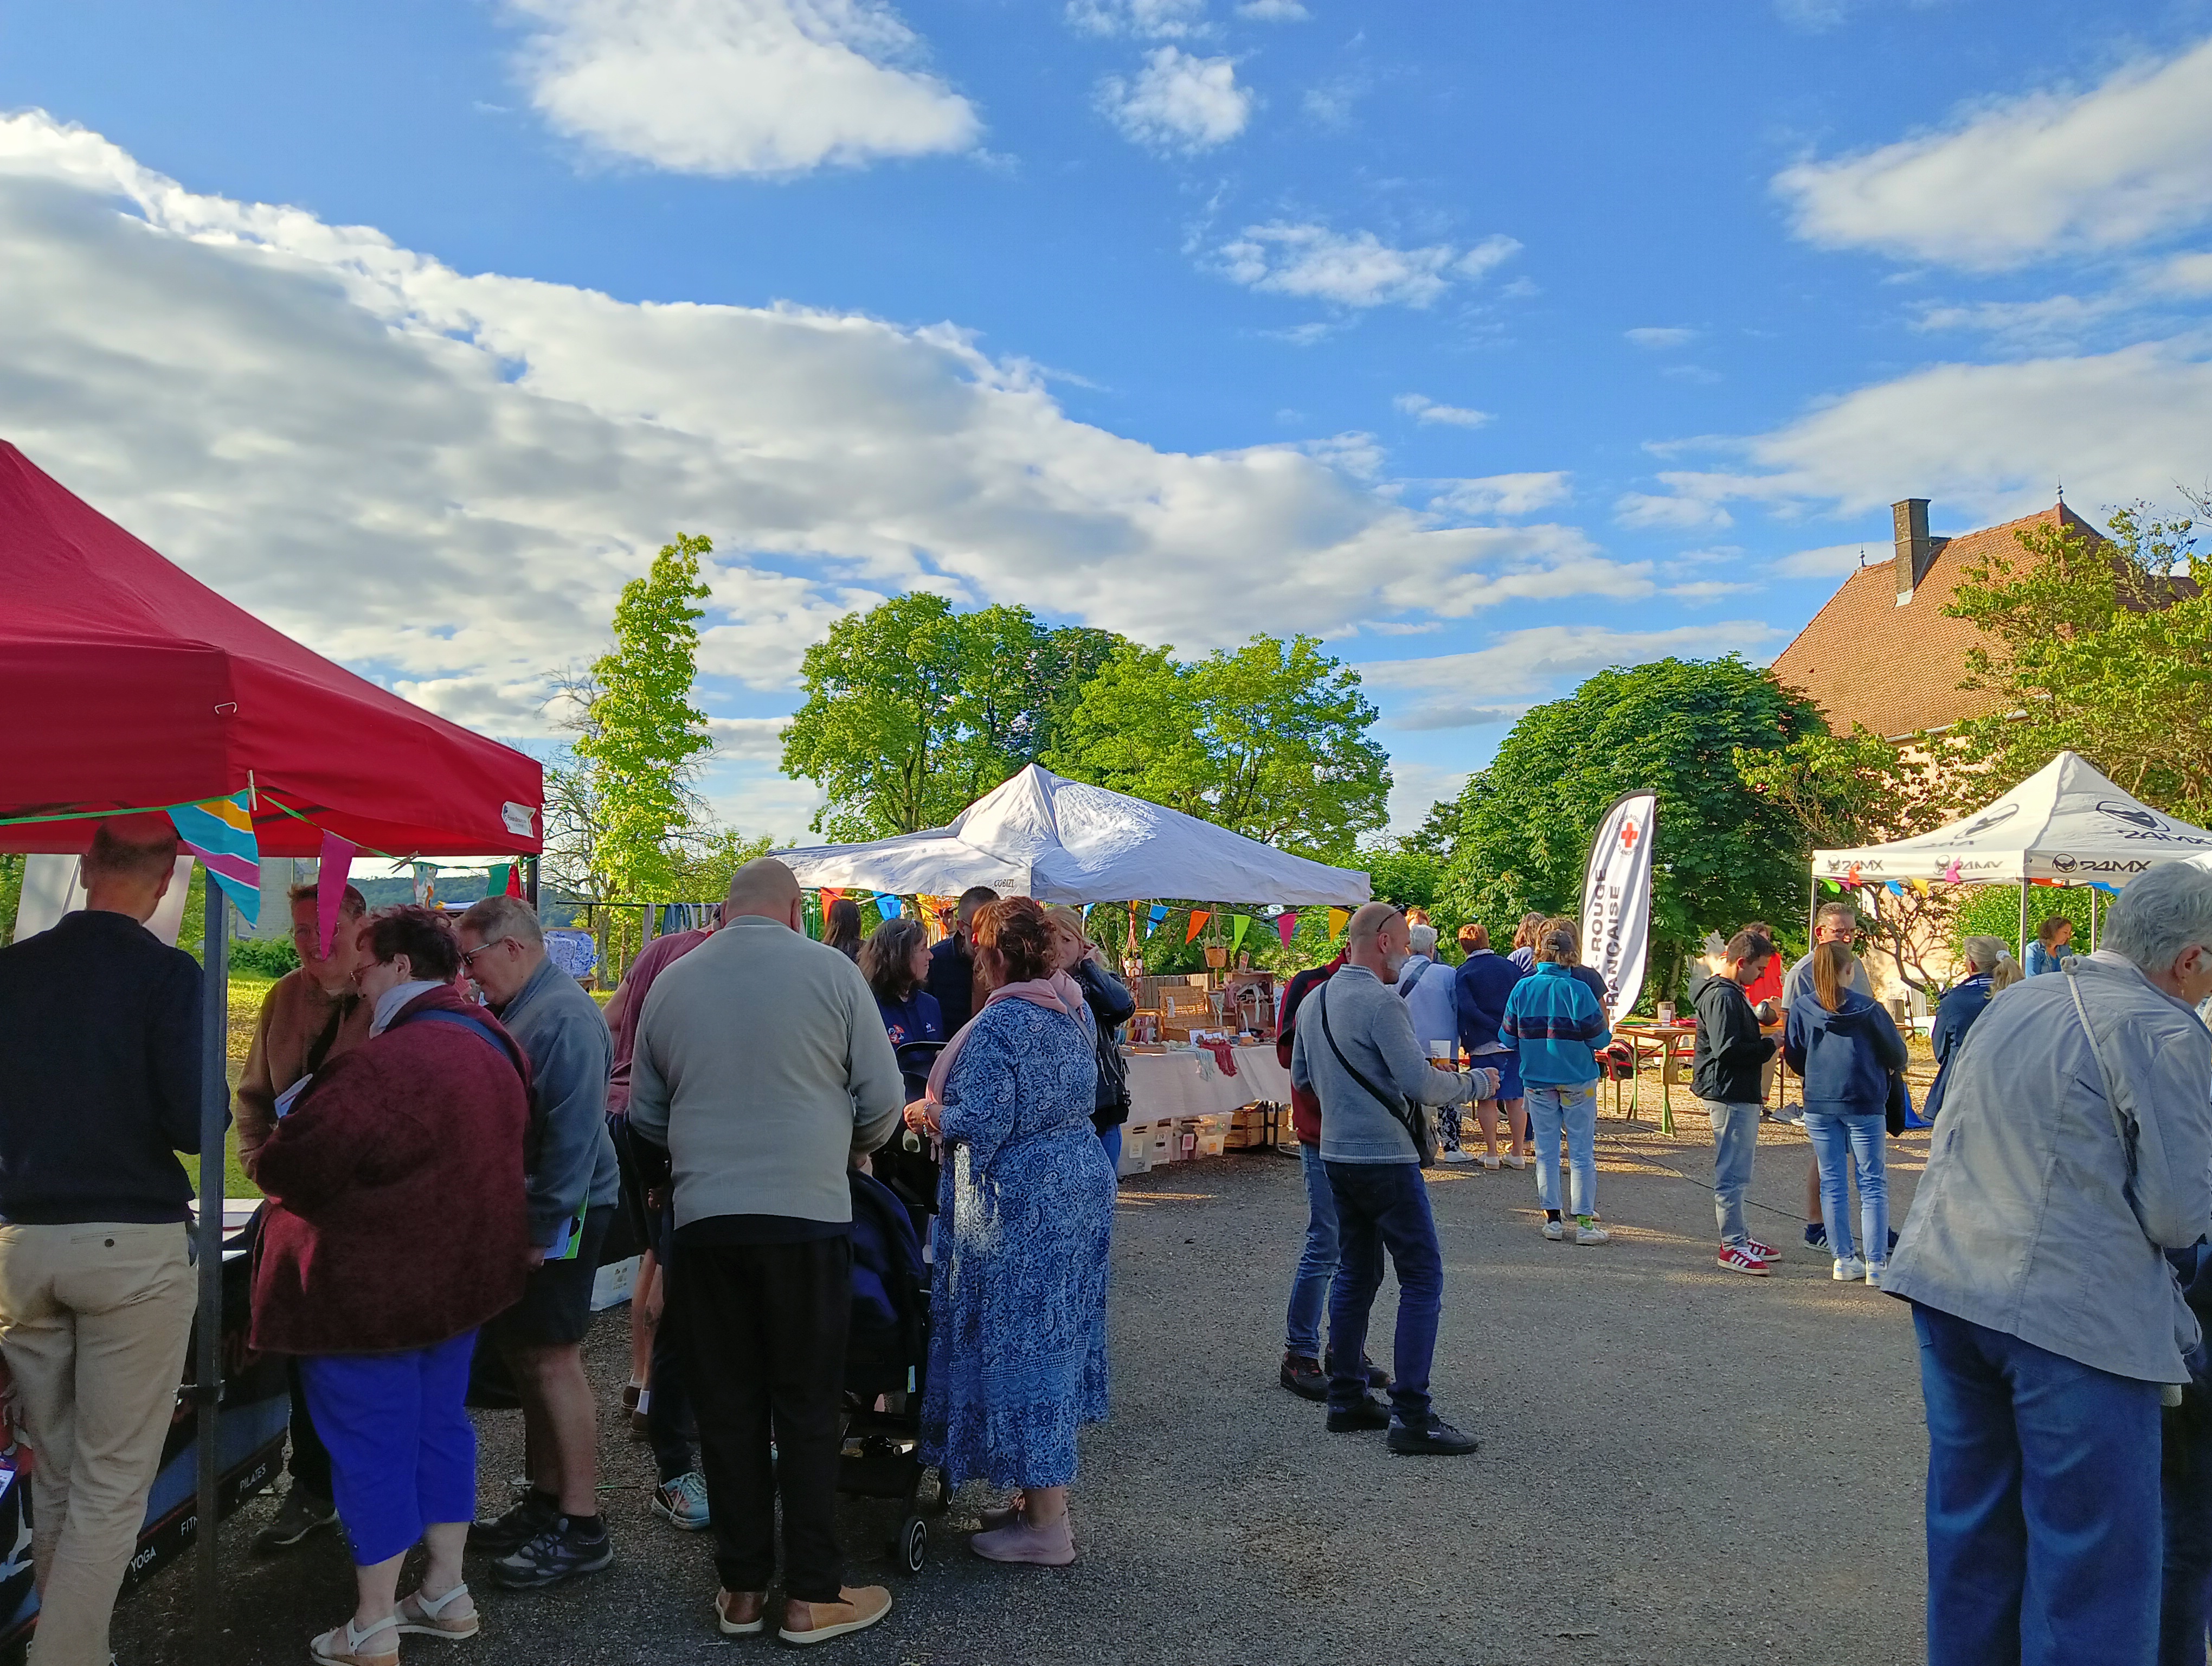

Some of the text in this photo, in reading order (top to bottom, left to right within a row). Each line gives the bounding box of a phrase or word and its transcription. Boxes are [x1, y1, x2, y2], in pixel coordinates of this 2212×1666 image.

[1842, 860, 1884, 872] 24MX
[2080, 860, 2152, 873] 24MX
[994, 879, 1014, 888] COBIZI
[1591, 868, 1607, 971] X-ROUGE
[240, 1463, 266, 1492] PILATES
[130, 1545, 157, 1572] YOGA
